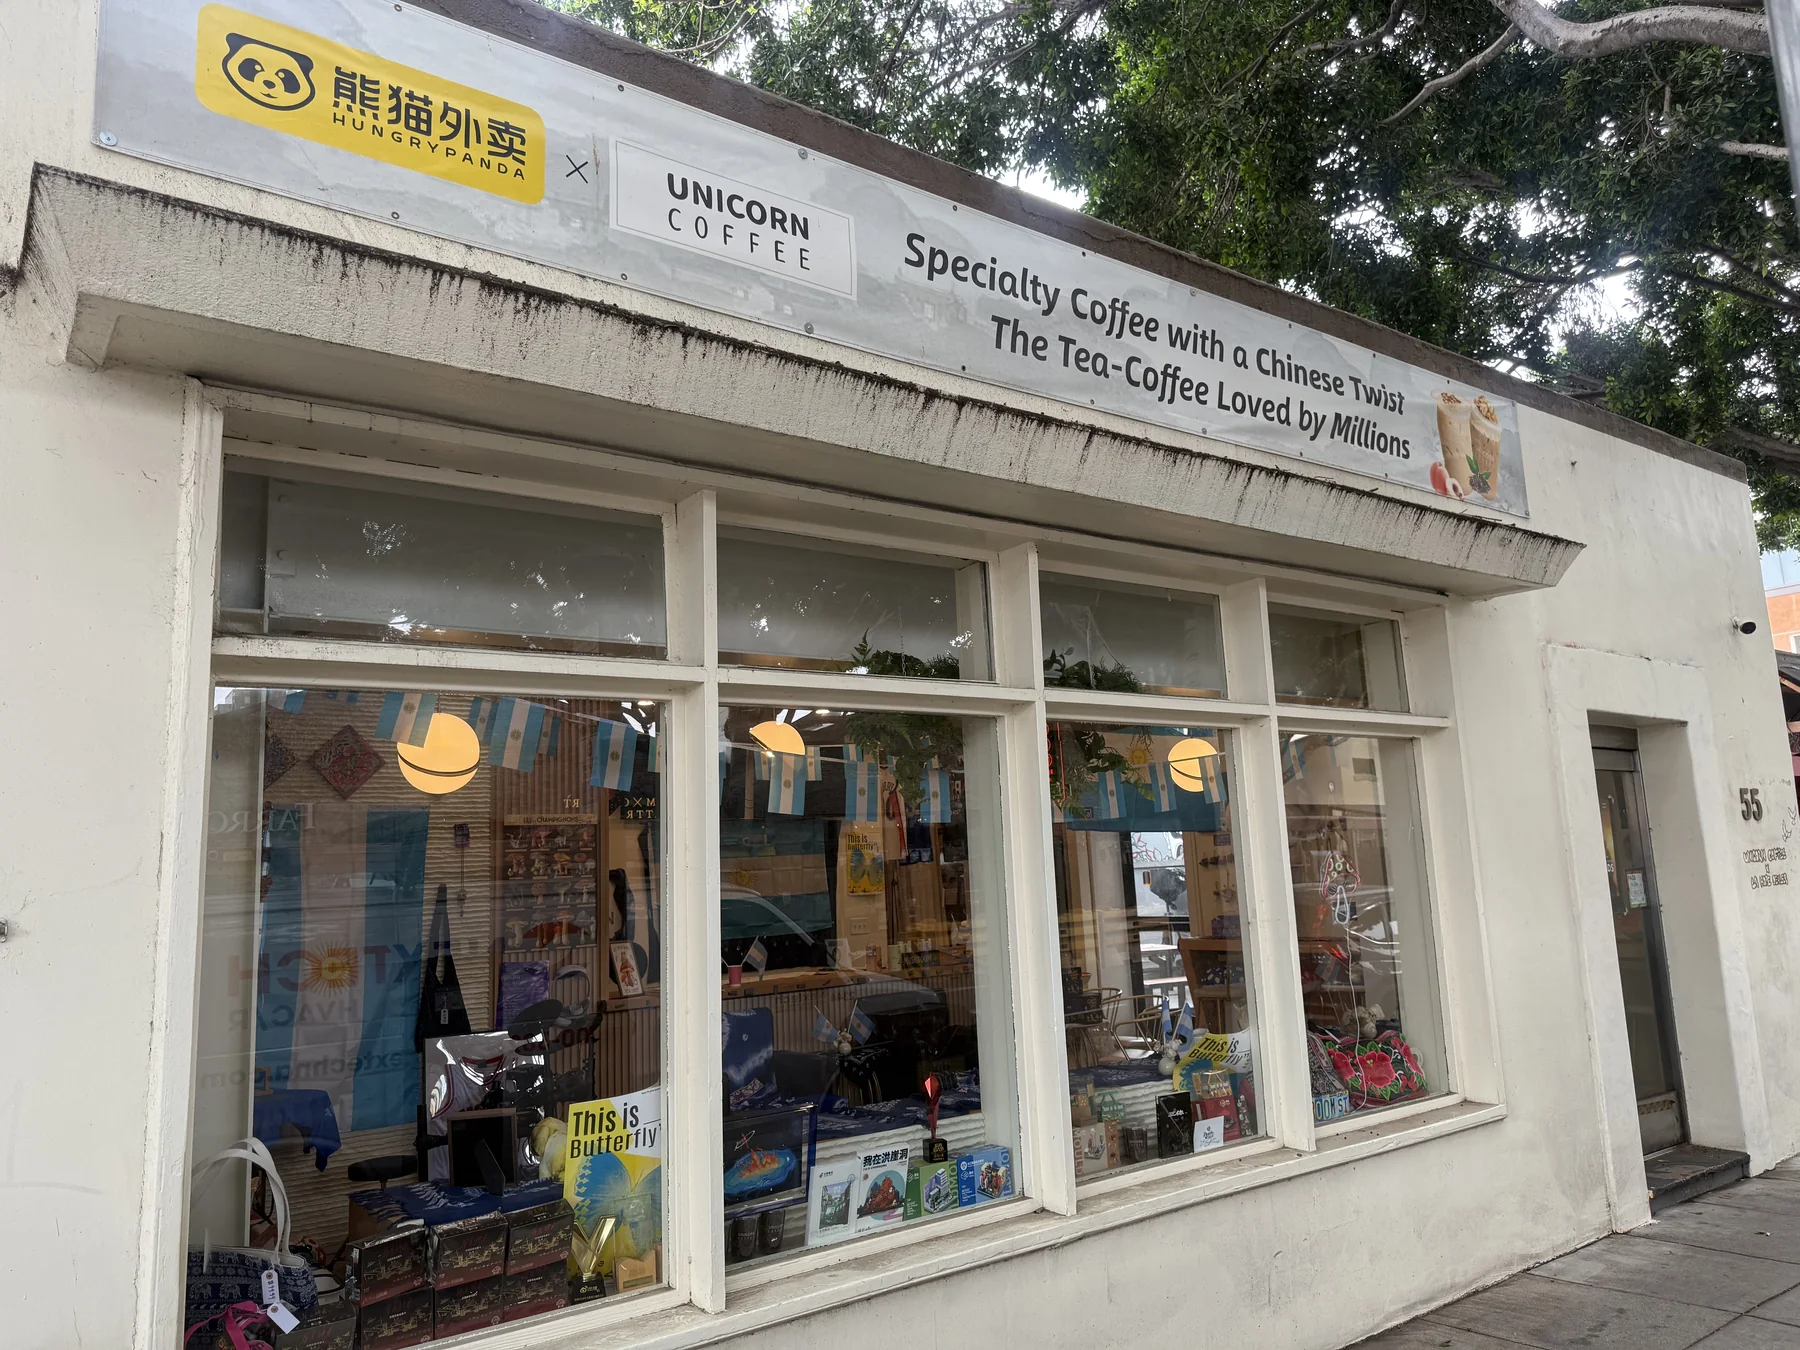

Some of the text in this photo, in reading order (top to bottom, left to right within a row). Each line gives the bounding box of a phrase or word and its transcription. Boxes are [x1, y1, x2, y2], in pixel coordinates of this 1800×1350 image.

[332, 66, 527, 166] 熊猫外卖
[332, 112, 526, 181] HUNGRYPANDA
[666, 172, 811, 241] UNICORN
[668, 207, 811, 272] COFFEE
[904, 232, 1406, 416] Specialty Coffee with a Chinese Twist
[991, 314, 1412, 461] The Tea-Coffee Loved by Millions
[1739, 787, 1763, 821] 55
[847, 833, 868, 843] This is
[1198, 1037, 1240, 1054] This is
[573, 1102, 640, 1137] This is
[1337, 1096, 1348, 1113] ST
